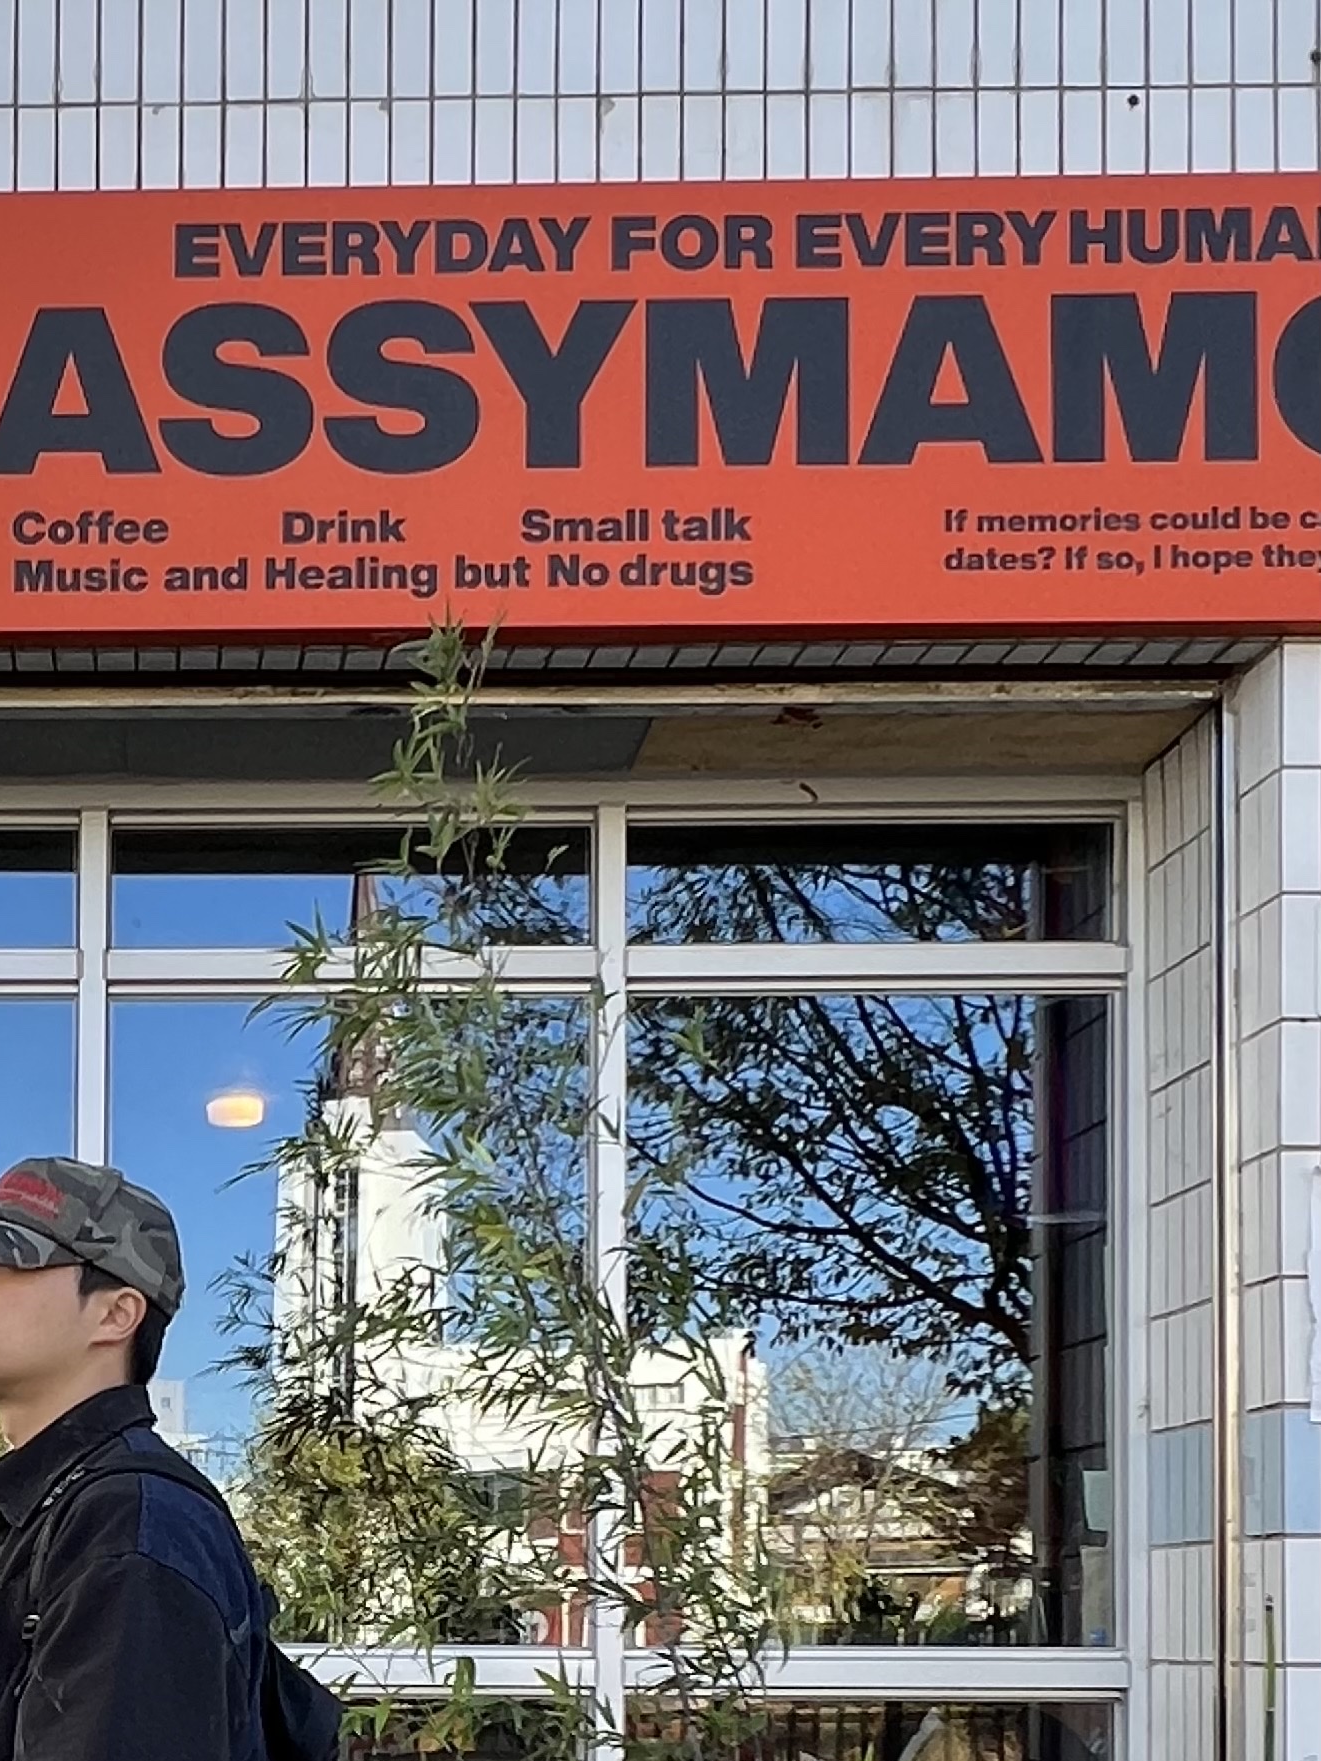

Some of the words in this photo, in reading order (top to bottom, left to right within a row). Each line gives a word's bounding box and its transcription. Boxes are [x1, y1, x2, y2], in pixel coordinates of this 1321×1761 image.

[175, 216, 591, 277] EVERYDAY
[611, 213, 773, 271] FOR
[795, 210, 1057, 269] EVERY
[1069, 206, 1321, 265] HUMA
[12, 510, 169, 545] Coffee
[282, 509, 406, 544] Drink
[521, 508, 649, 544] Small
[661, 507, 751, 542] talk
[945, 509, 967, 532] If
[977, 508, 1140, 533] memories
[1150, 506, 1241, 532] could
[1250, 506, 1290, 530] be
[1300, 511, 1321, 530] c
[13, 558, 149, 592] Music
[164, 557, 247, 592] and
[265, 555, 438, 599] Healing
[455, 555, 531, 590] but
[548, 554, 610, 587] No
[620, 553, 753, 596] drugs
[945, 546, 1056, 571] dates?
[1065, 546, 1087, 570] If
[1097, 551, 1144, 574] so,
[1154, 545, 1161, 569] I
[1171, 544, 1253, 575] hope
[1262, 544, 1321, 569] the
